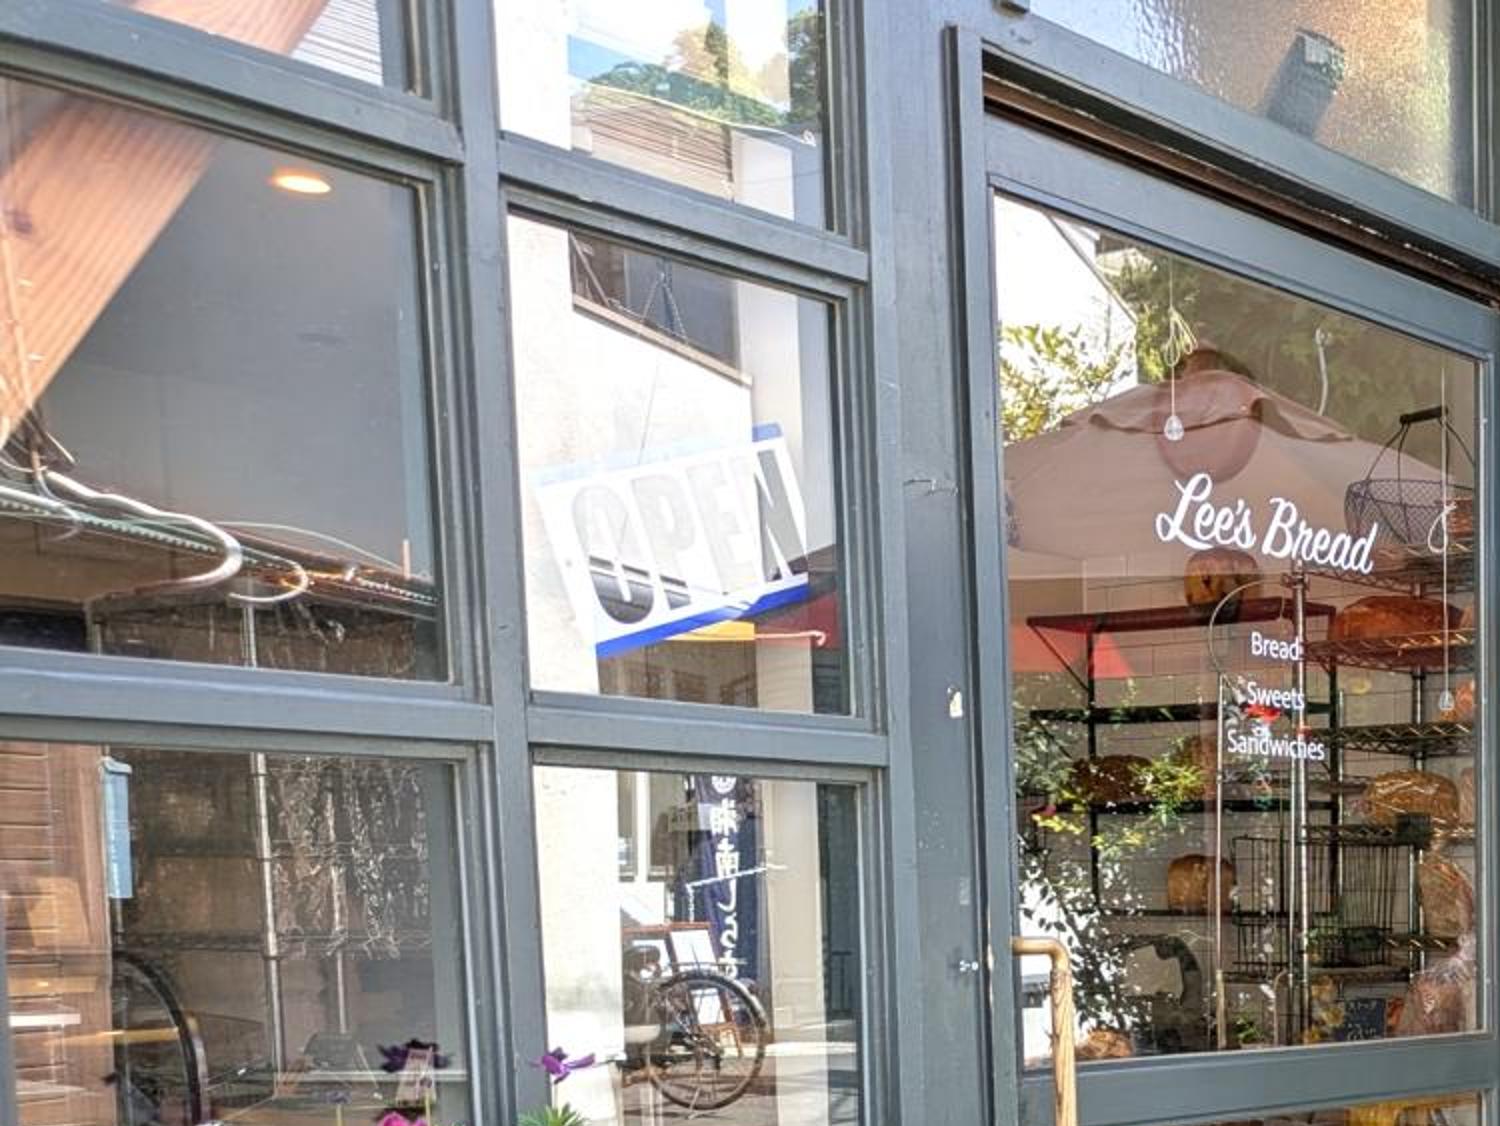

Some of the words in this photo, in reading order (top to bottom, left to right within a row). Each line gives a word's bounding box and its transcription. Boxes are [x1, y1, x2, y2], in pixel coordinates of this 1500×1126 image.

[572, 448, 807, 624] OPEN
[1155, 473, 1256, 550] Lee's
[1262, 497, 1378, 574] Bread
[1250, 631, 1301, 661] Bread
[1247, 681, 1305, 711] Sweets
[1227, 729, 1325, 761] Sandwiches
